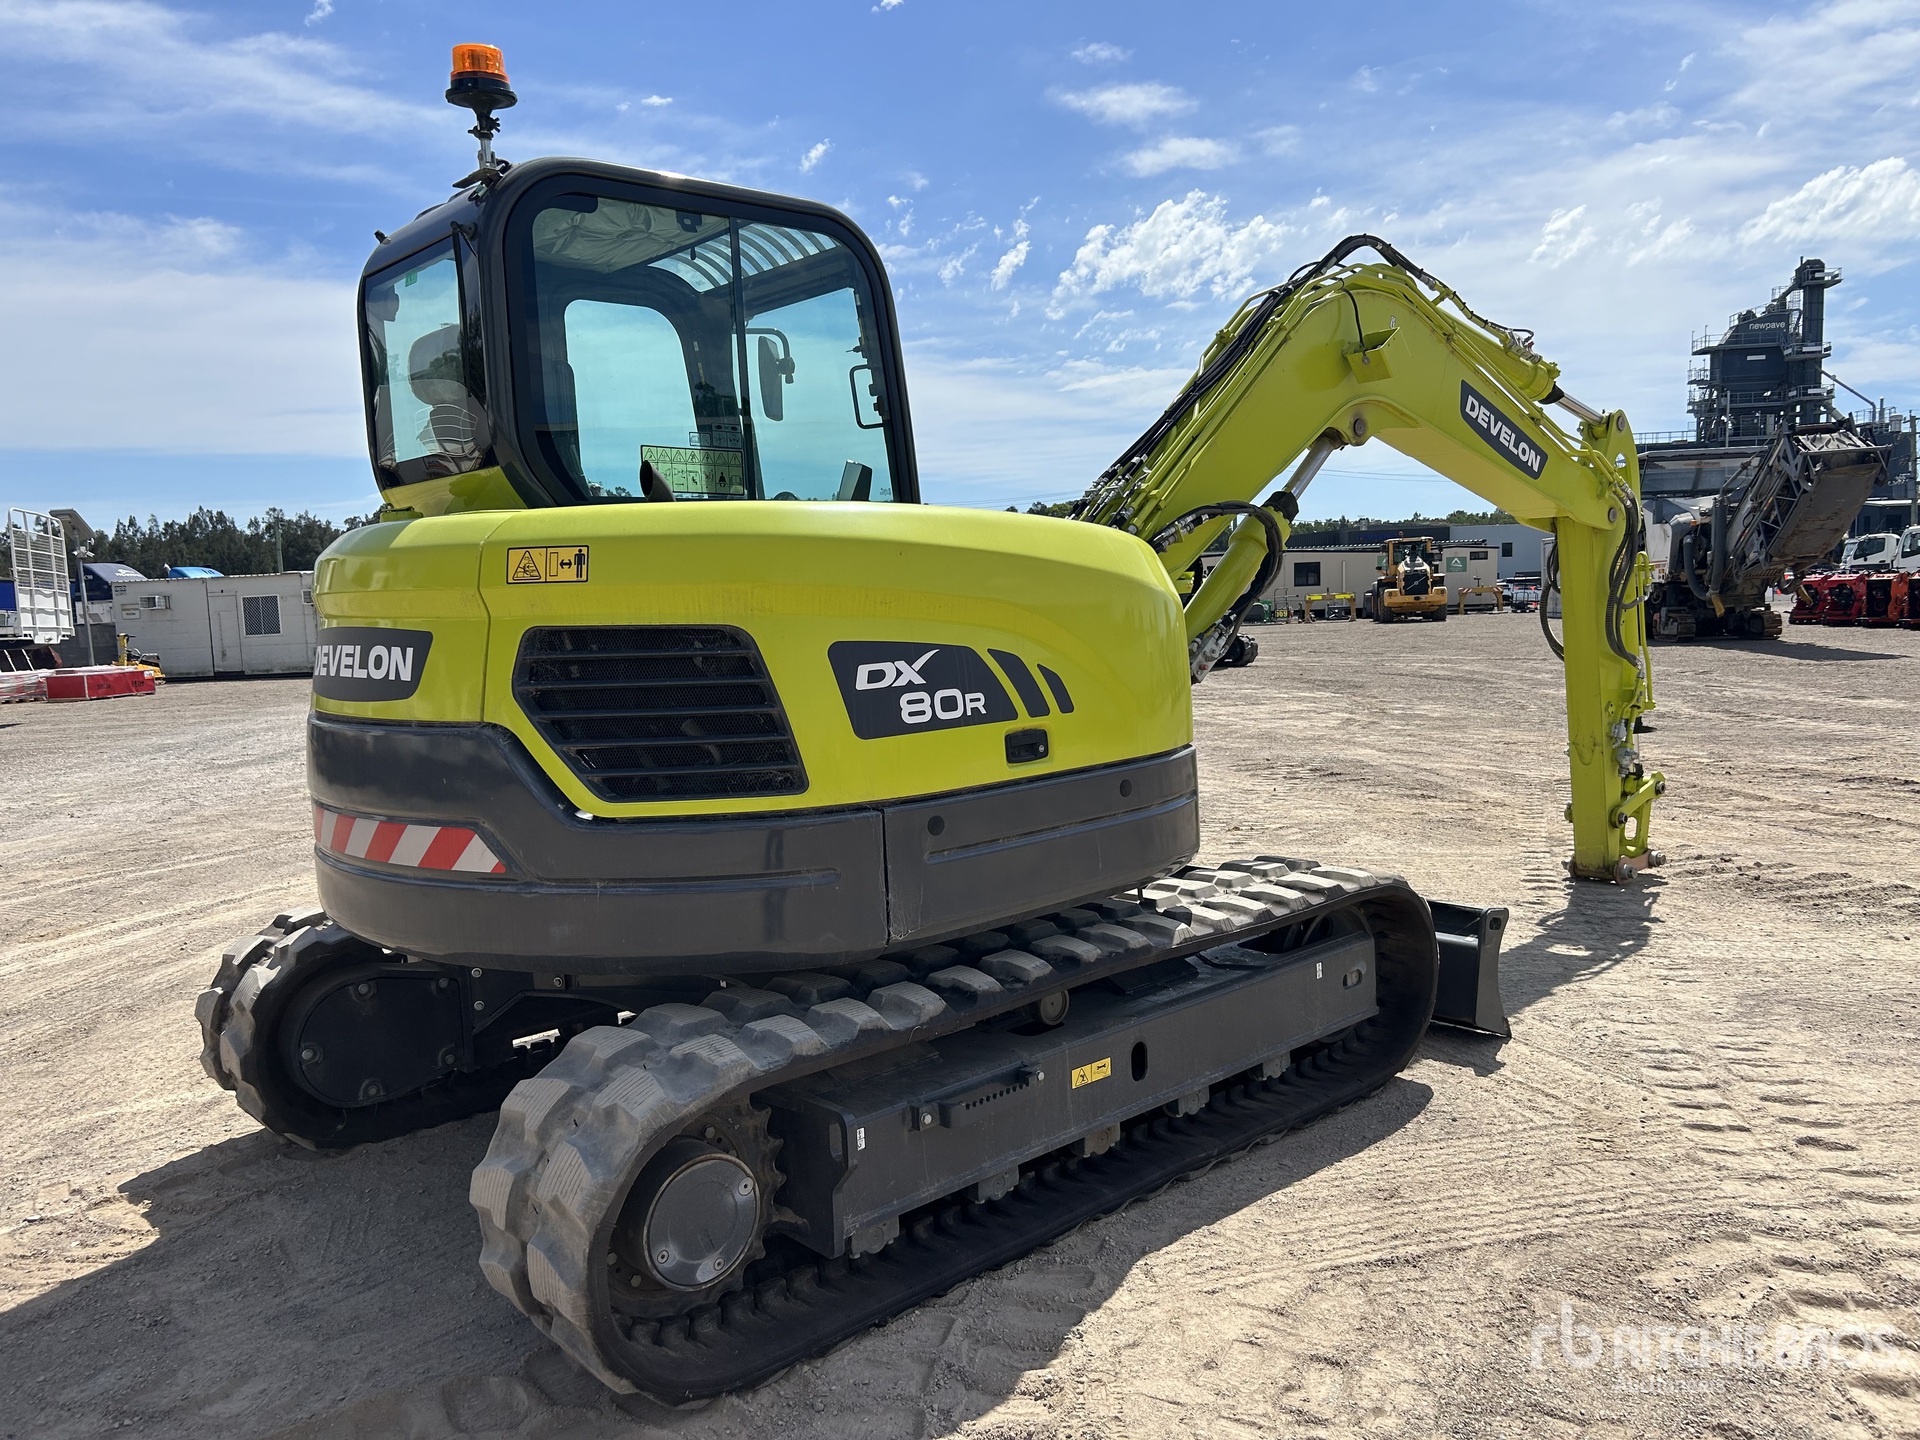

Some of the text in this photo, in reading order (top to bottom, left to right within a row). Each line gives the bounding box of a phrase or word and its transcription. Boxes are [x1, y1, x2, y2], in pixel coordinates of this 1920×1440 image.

[1749, 321, 1786, 331] newpave
[1465, 394, 1541, 473] DEVELON
[314, 645, 414, 681] DEVELON
[855, 649, 940, 691] DX
[899, 688, 988, 724] 80R
